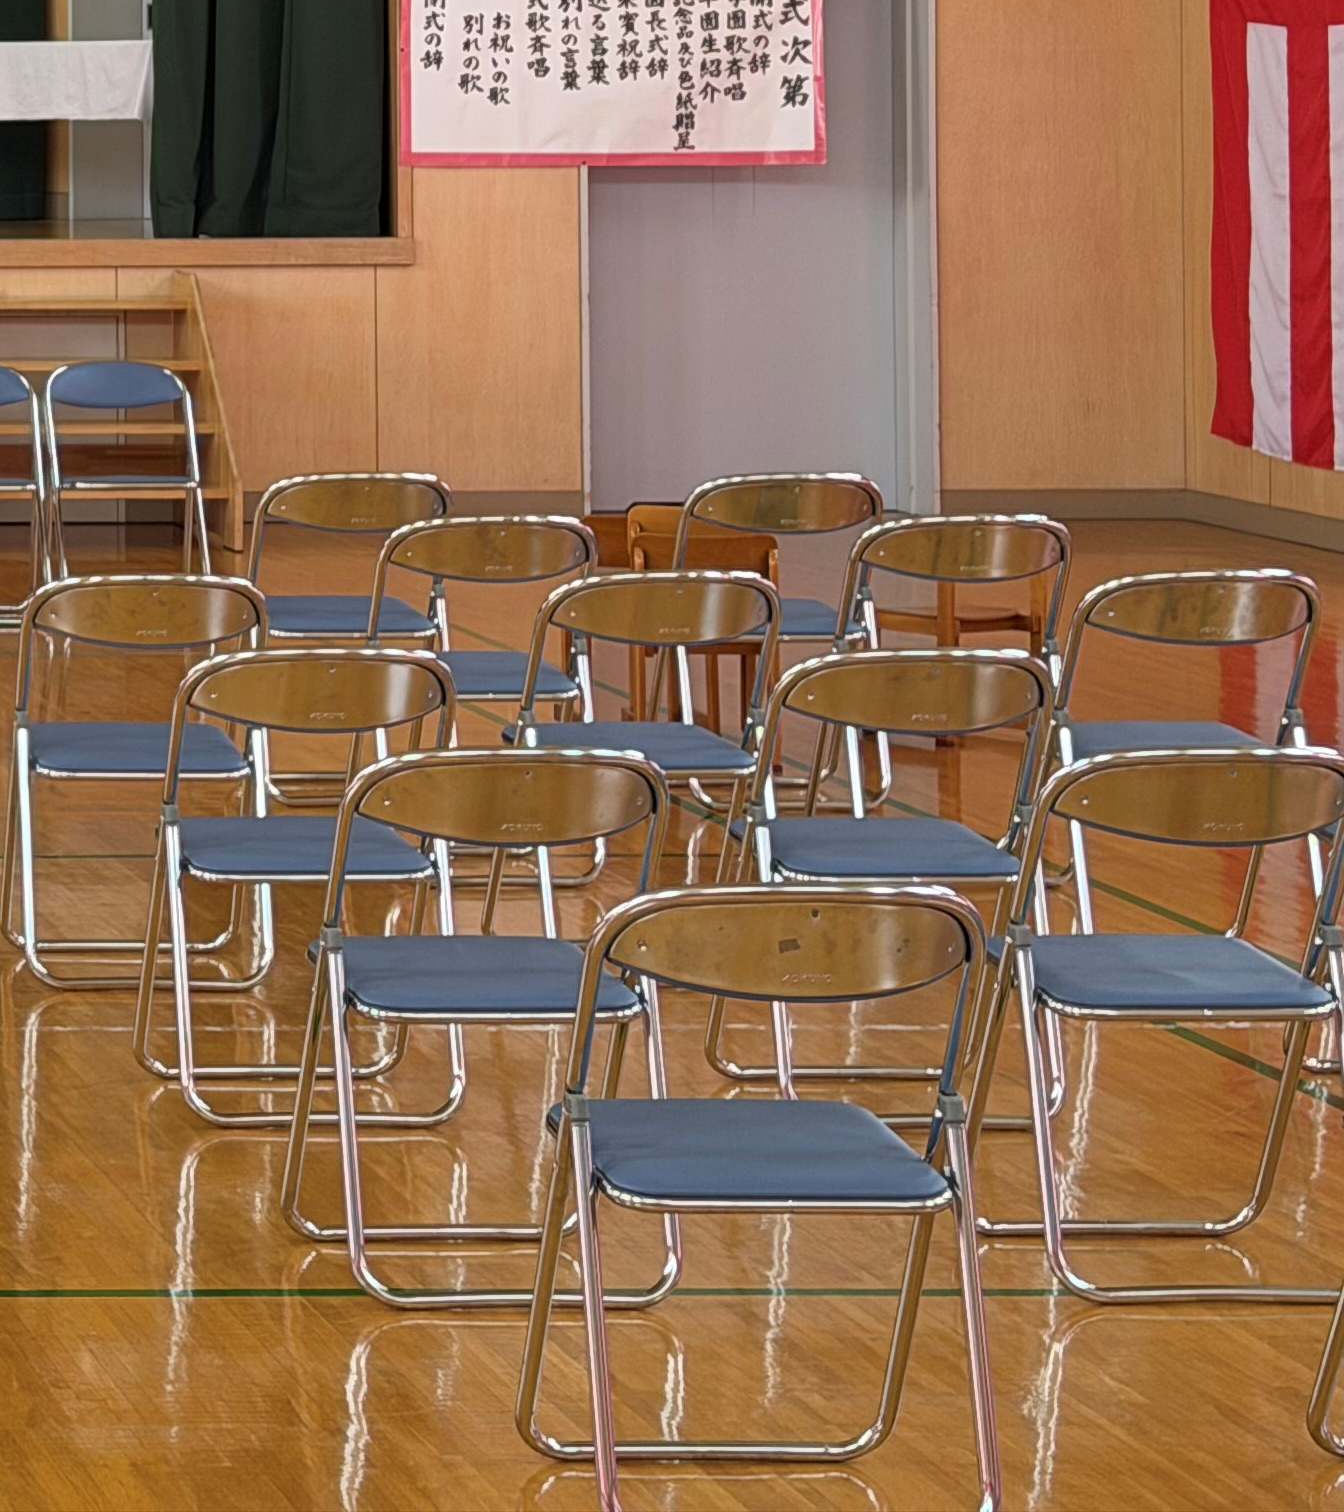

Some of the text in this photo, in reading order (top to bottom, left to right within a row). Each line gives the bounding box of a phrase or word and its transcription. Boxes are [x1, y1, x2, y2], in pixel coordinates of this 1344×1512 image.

[458, 13, 484, 94] 別れの歌
[488, 12, 514, 106] お祝いの歌
